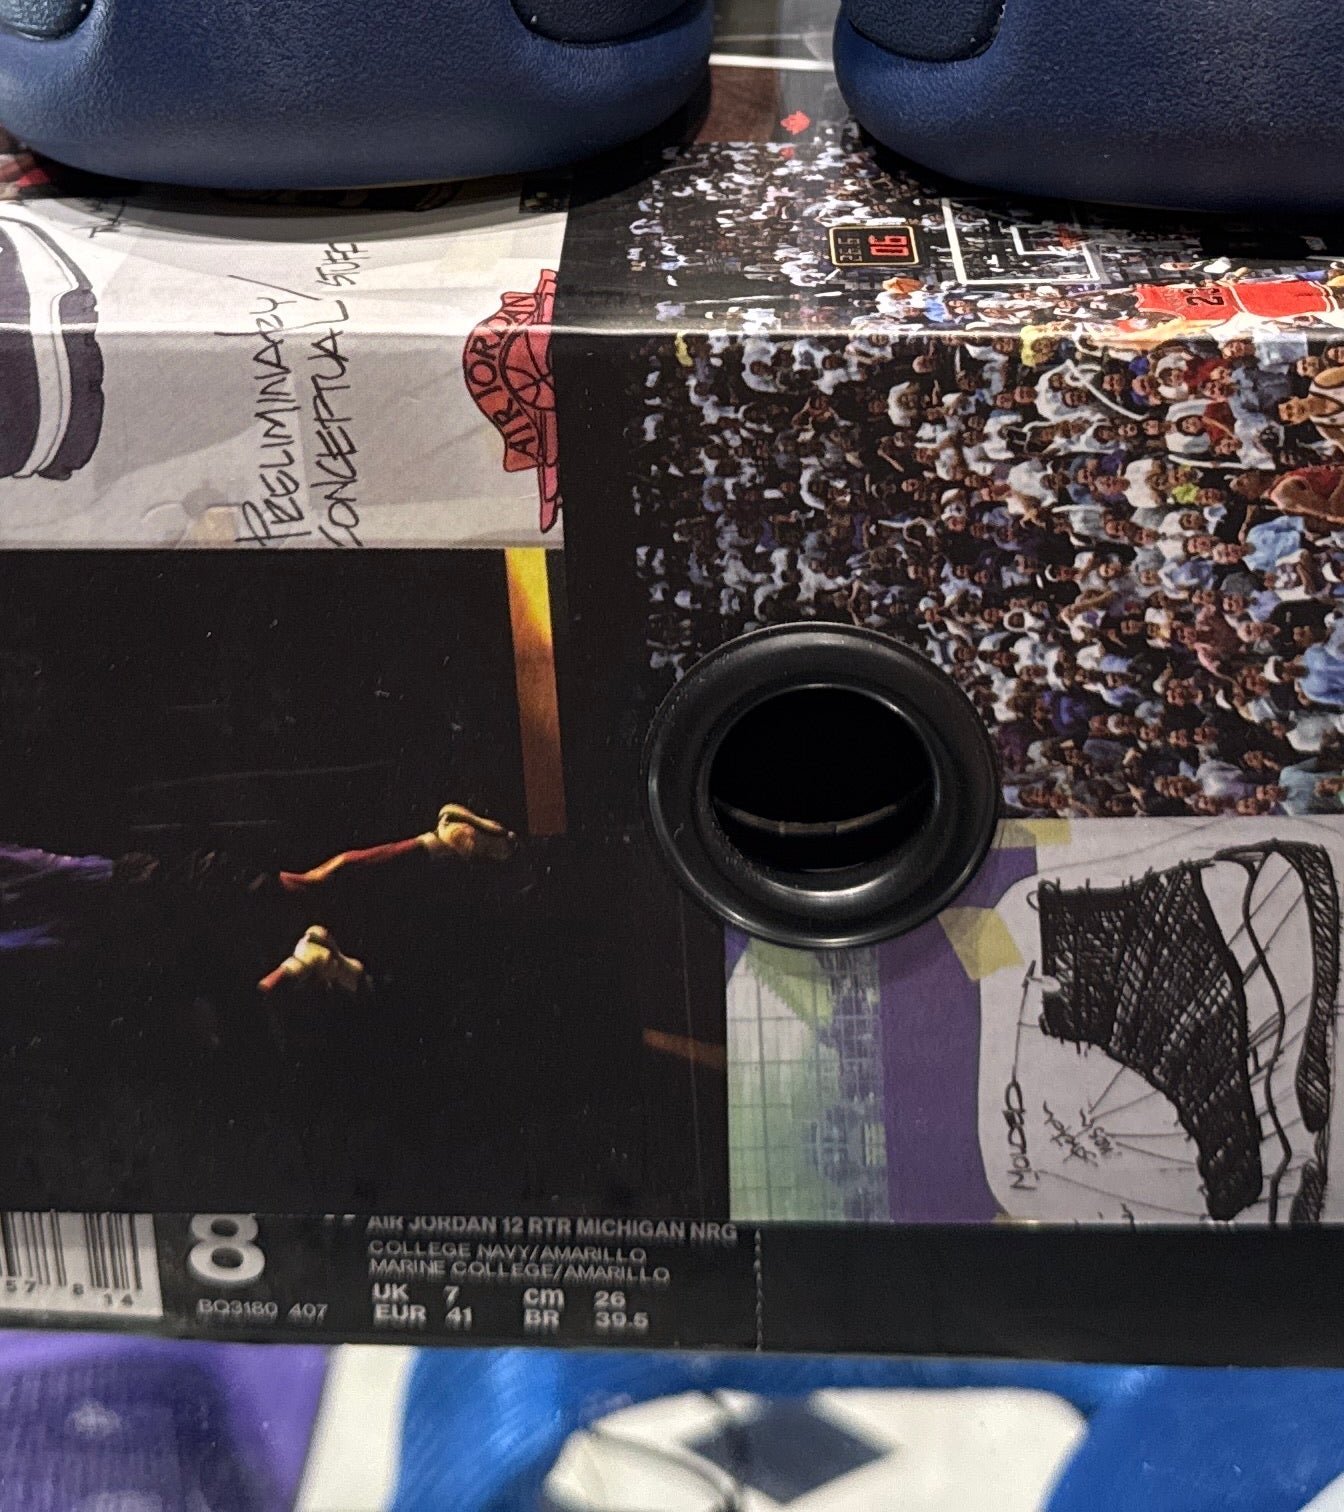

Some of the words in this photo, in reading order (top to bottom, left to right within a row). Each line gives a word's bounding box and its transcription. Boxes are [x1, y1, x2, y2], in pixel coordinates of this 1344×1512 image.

[281, 299, 365, 548] CONCEPTUAL
[492, 397, 537, 460] AIR
[366, 1215, 404, 1232] AIR
[408, 1215, 497, 1235] JORDAN
[502, 1216, 524, 1235] 12
[527, 1217, 571, 1237] RTR
[576, 1218, 686, 1240] MICHIGAN
[690, 1222, 738, 1242] NRG
[188, 1212, 266, 1282] 8
[368, 1240, 470, 1259] COLLEGE
[476, 1244, 647, 1263] NAVY/AMARILLO
[368, 1258, 446, 1277] MARINE
[450, 1261, 670, 1283] COLLEGE/AMARILLO
[102, 1292, 134, 1307] 14
[197, 1297, 279, 1317] BQ3180
[288, 1302, 329, 1320] 407
[373, 1283, 409, 1302] UK
[444, 1285, 460, 1304] 7
[523, 1288, 565, 1306] cm
[593, 1290, 626, 1308] 26
[373, 1303, 427, 1324] EUR
[444, 1305, 474, 1324] 41
[524, 1308, 560, 1327] BR
[594, 1311, 650, 1330] 39.5
